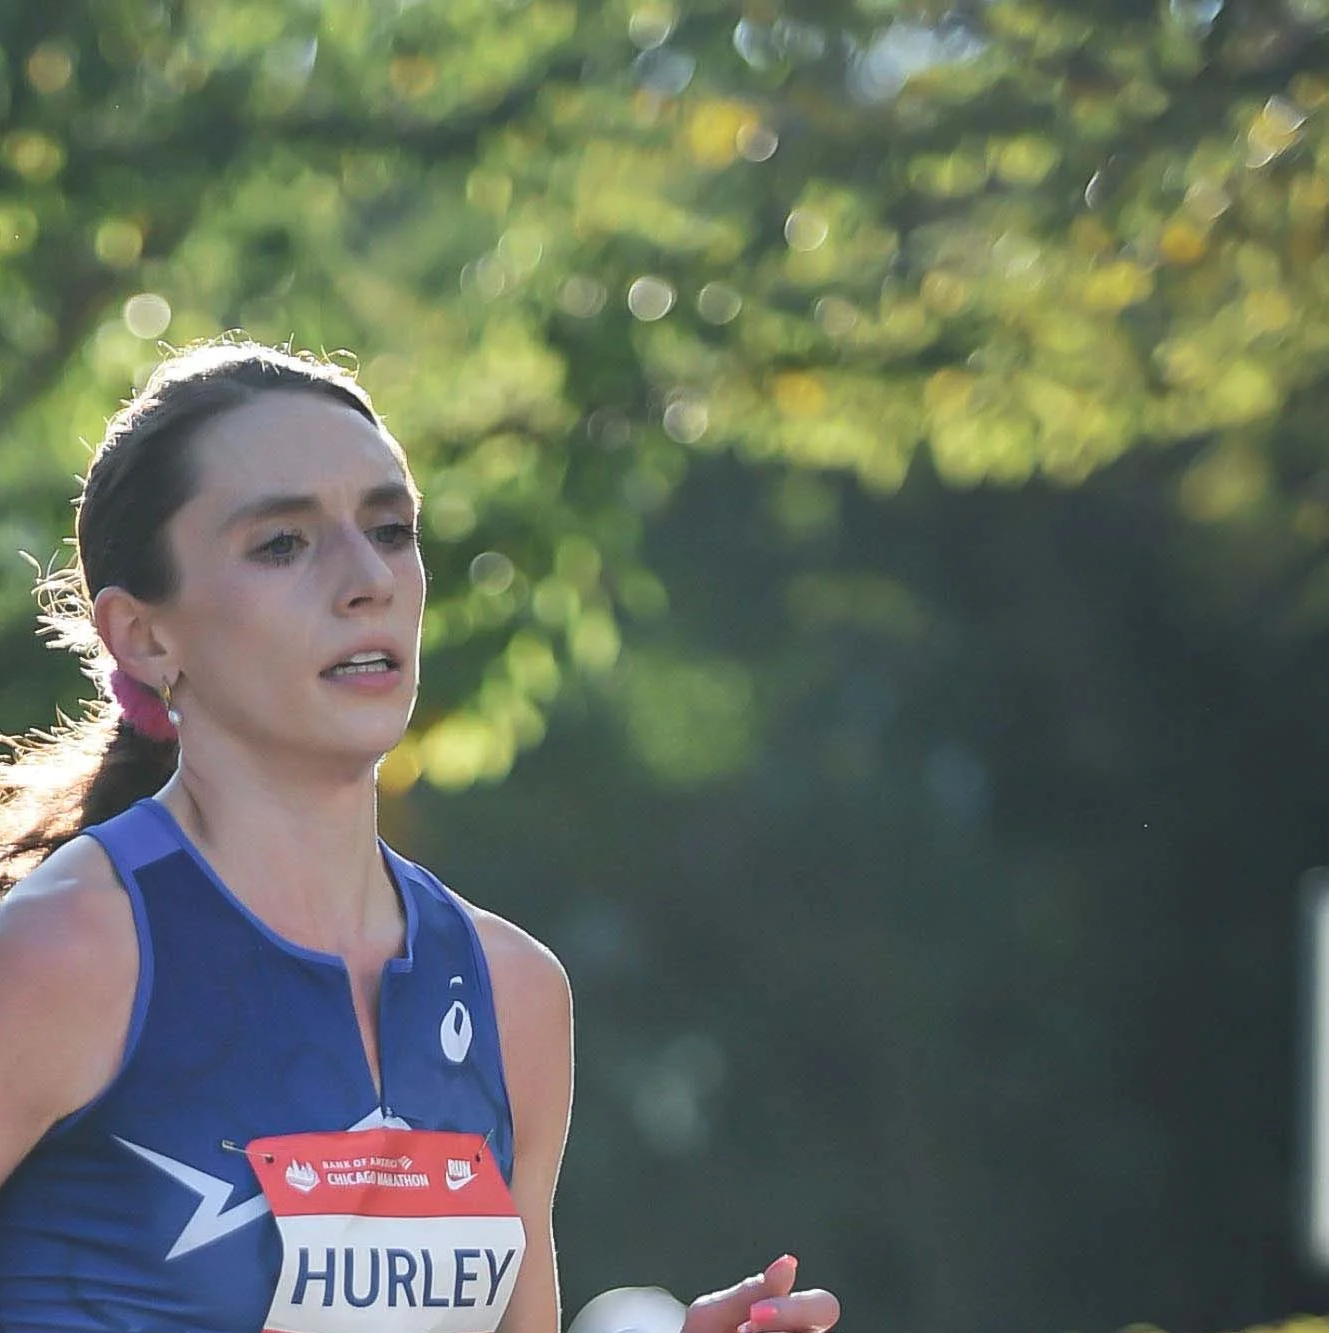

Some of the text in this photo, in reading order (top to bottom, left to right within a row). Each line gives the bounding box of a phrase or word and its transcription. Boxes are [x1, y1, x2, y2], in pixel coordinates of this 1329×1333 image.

[322, 1160, 351, 1169] BANK
[353, 1158, 367, 1168] OF
[447, 1158, 472, 1178] RUN
[327, 1171, 430, 1187] CHICAGO MARATHON
[291, 1247, 516, 1308] HURLEY
